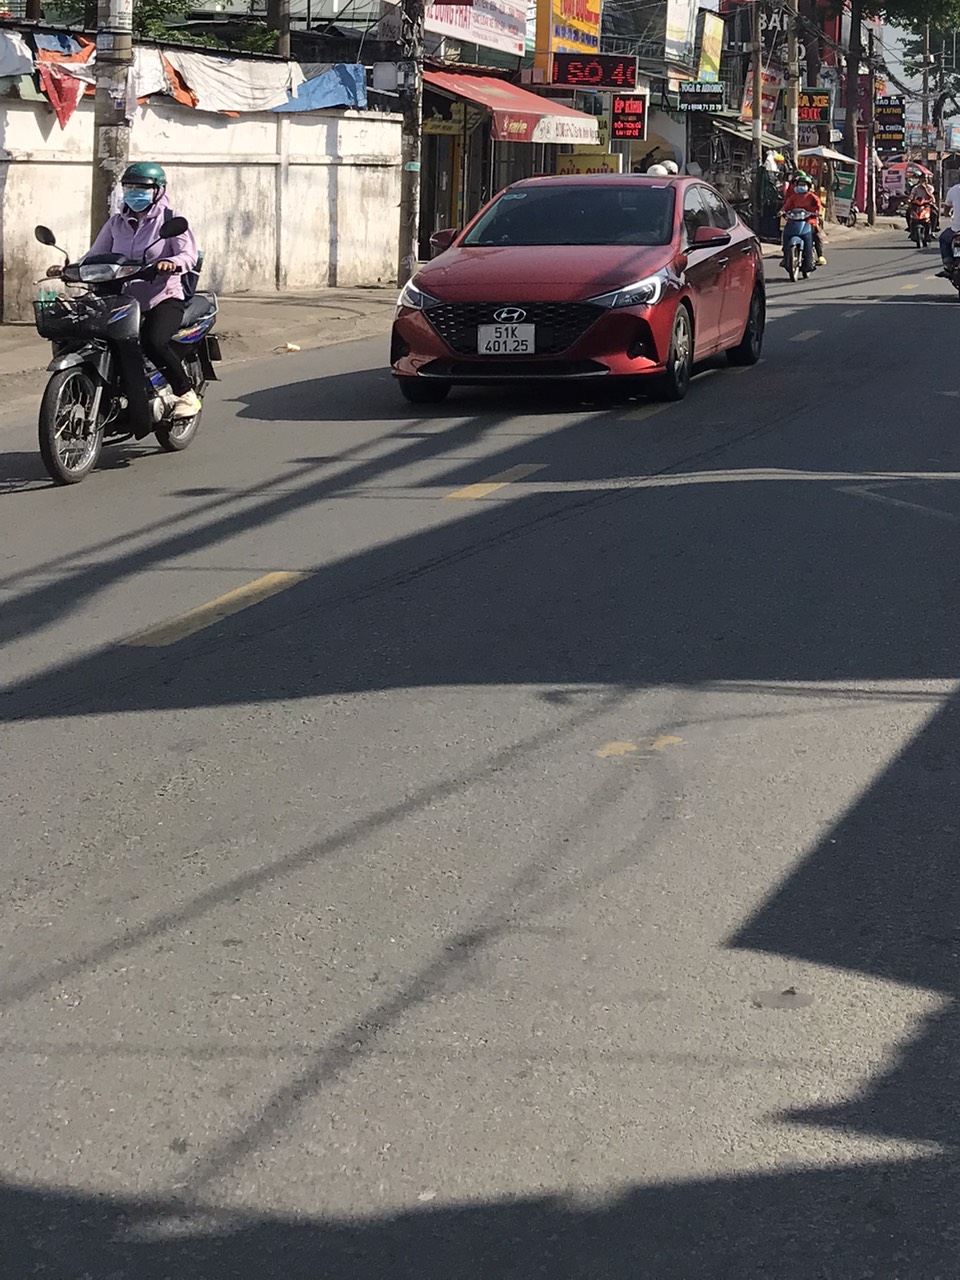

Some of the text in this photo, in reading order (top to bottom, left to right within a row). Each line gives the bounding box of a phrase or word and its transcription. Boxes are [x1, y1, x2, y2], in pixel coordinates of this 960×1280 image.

[812, 95, 829, 107] XE
[494, 326, 518, 339] 51K
[485, 339, 529, 352] 401.25
